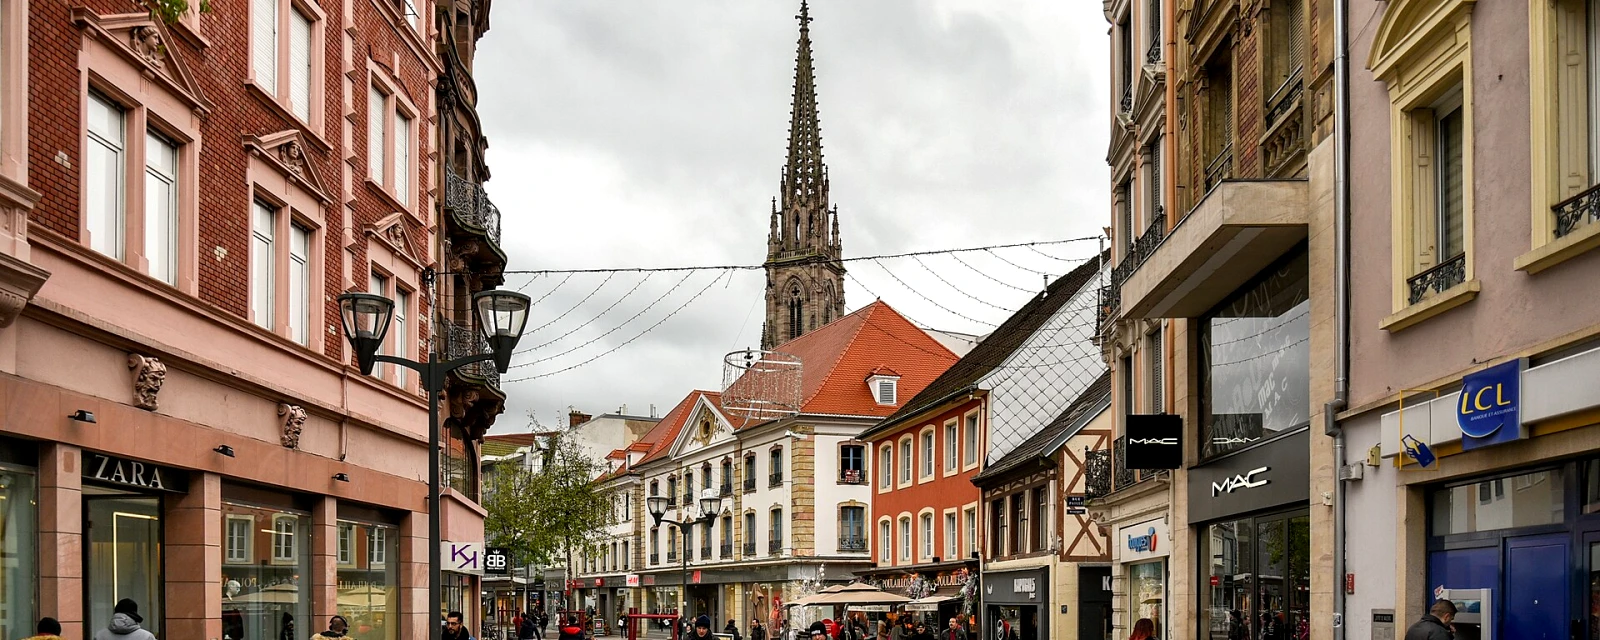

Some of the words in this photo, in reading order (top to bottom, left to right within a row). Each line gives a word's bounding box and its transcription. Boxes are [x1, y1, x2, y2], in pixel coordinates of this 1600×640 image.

[1461, 382, 1511, 415] LCL
[1470, 413, 1488, 421] BANQUE
[1494, 406, 1516, 416] ASSURANCE
[95, 454, 164, 490] ZARA
